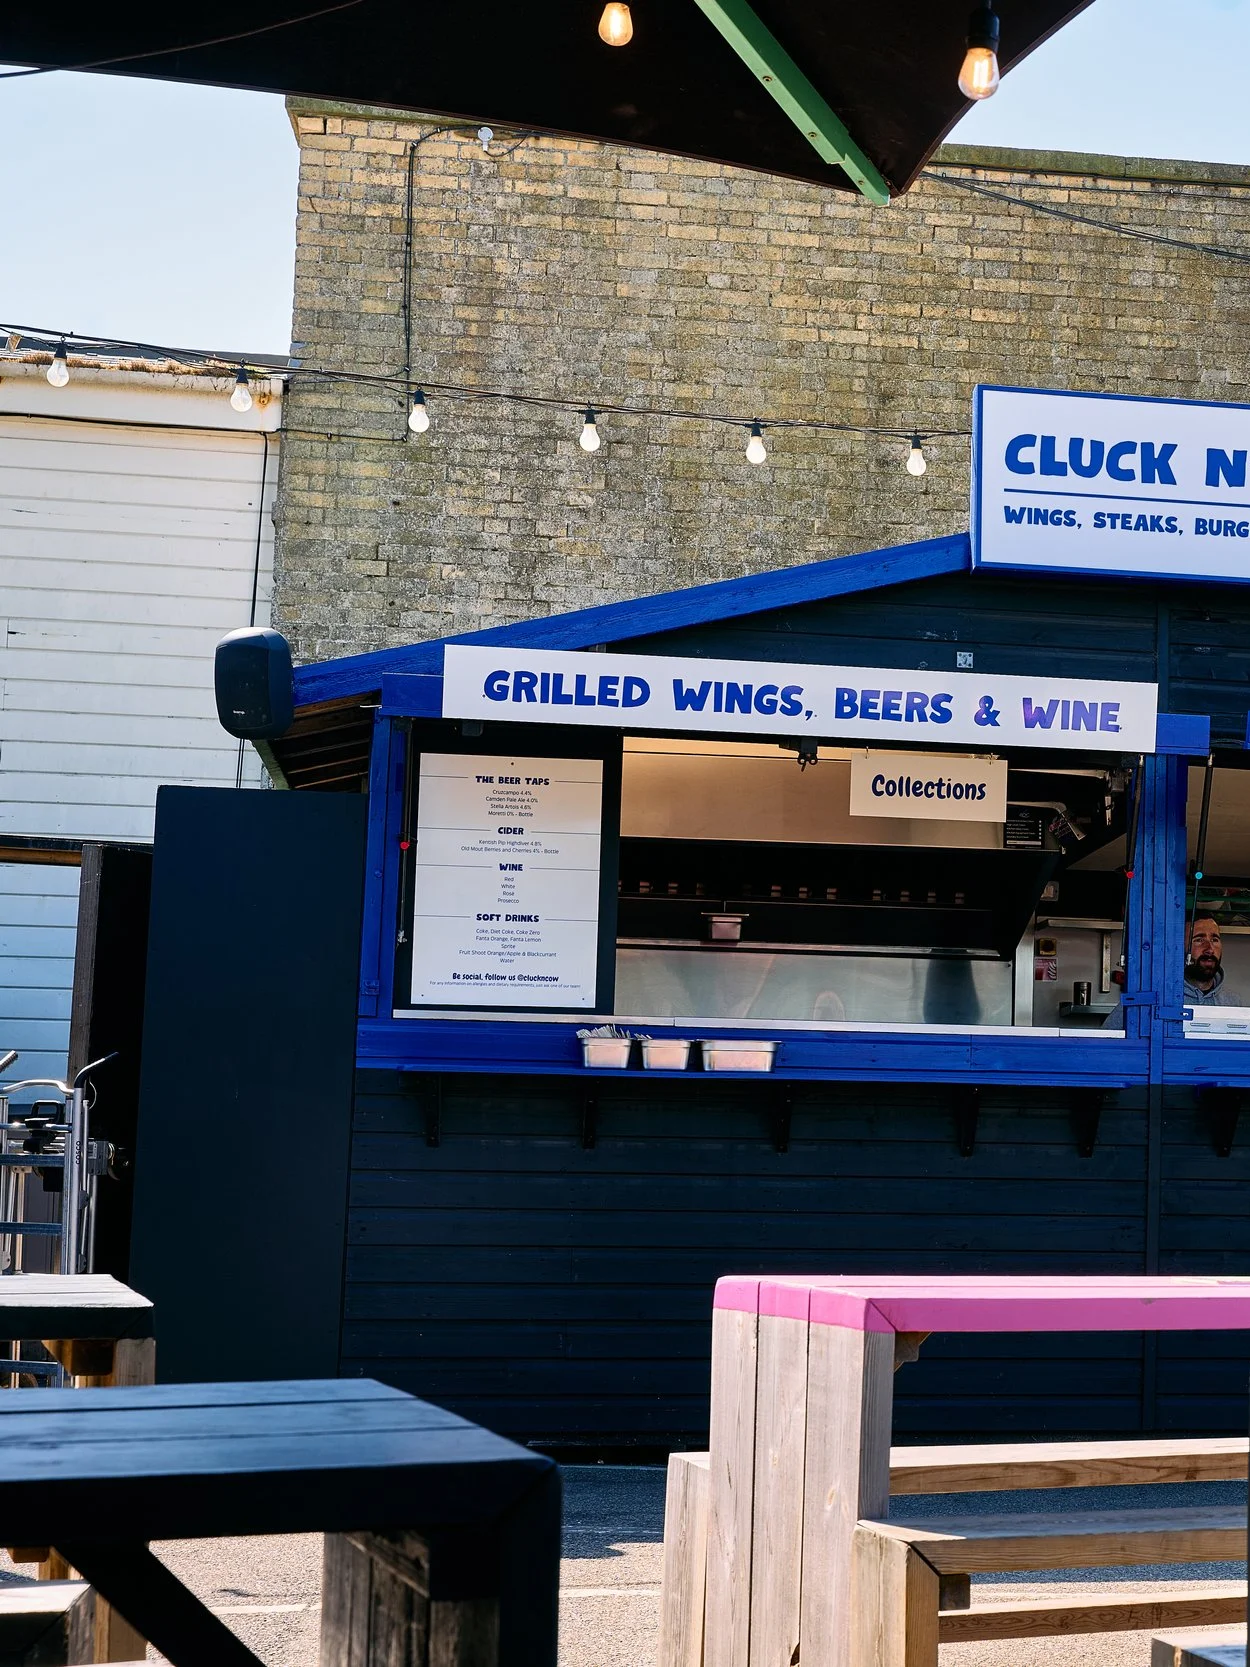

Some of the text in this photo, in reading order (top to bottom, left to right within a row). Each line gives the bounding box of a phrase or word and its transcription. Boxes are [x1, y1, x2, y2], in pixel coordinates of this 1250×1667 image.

[1004, 434, 1178, 485] CLUCK
[1004, 505, 1082, 530] WINGS,
[1093, 511, 1183, 536] STEAKS,
[484, 670, 1121, 732] GRILLED WINGS, BEERS & WINE
[498, 776, 521, 784] BEER
[871, 774, 987, 801] Collections
[498, 827, 524, 835] CIDER
[499, 863, 523, 871] WINE
[505, 914, 539, 922] DRINKS
[517, 974, 559, 982] @cluckncow
